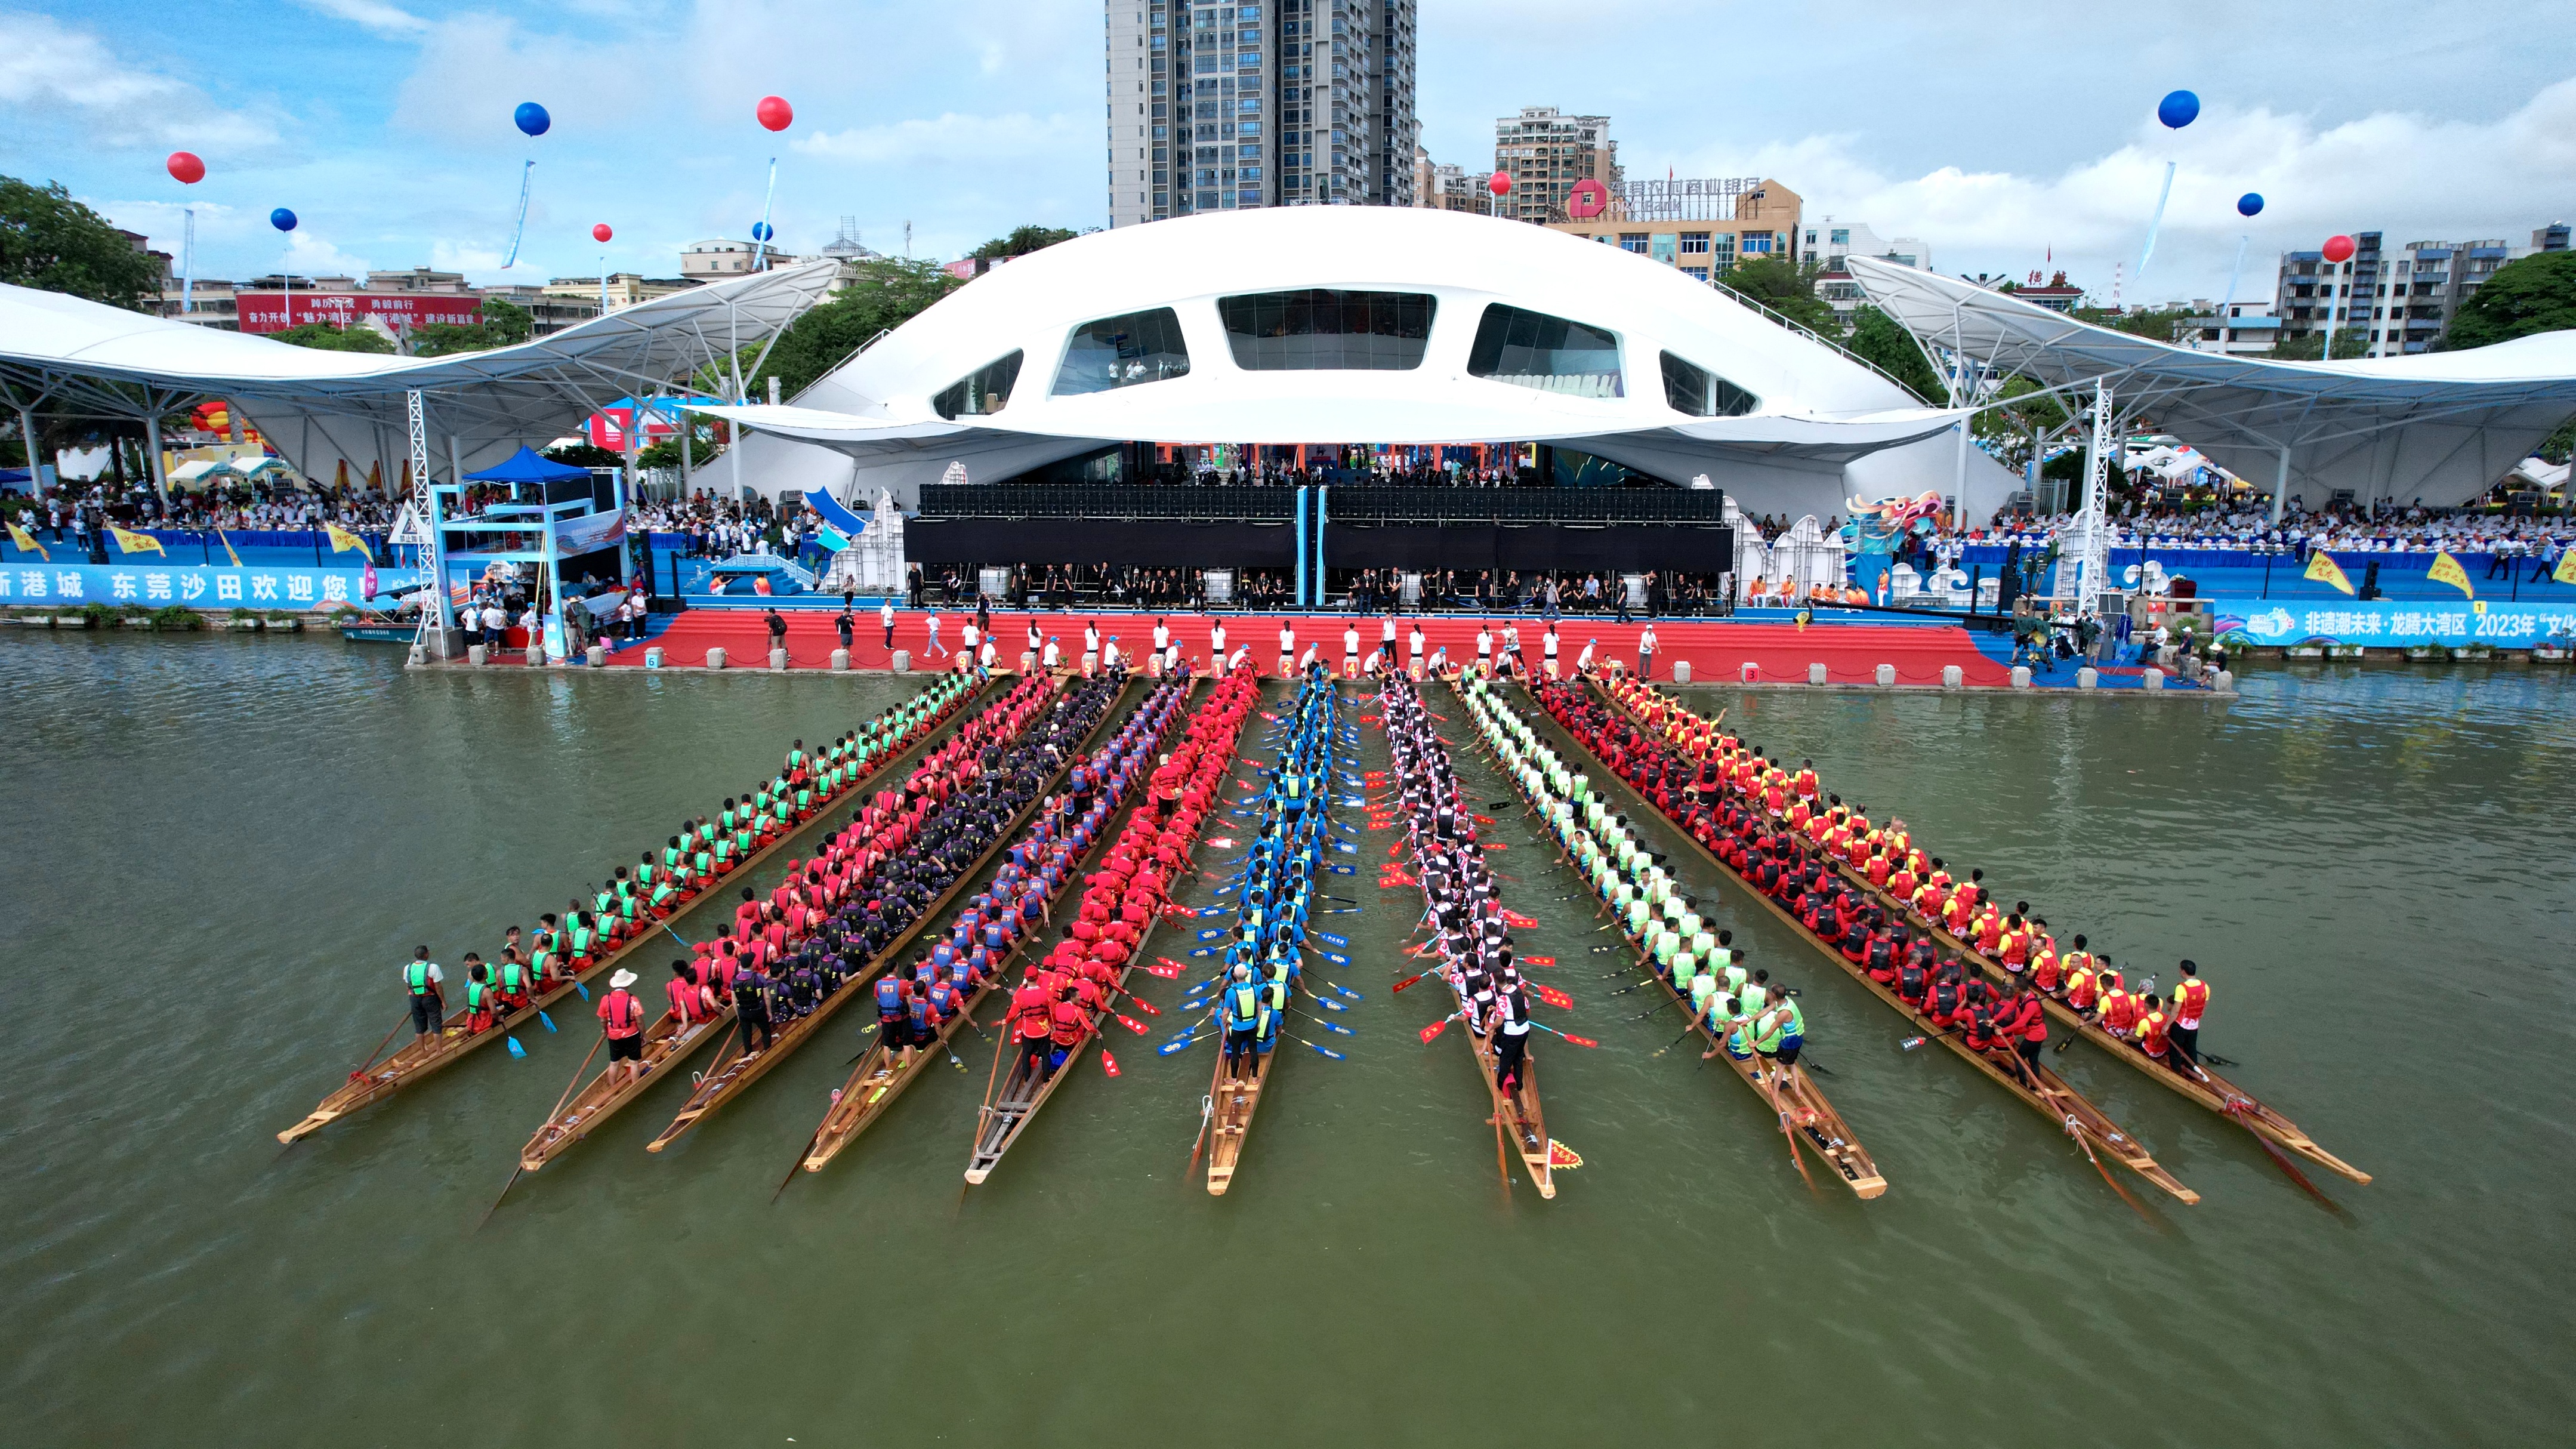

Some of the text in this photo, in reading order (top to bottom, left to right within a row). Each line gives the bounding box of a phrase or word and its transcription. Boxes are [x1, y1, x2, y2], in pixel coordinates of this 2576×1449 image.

[1611, 177, 1760, 198] 东莞农村商业银行
[1611, 199, 1682, 213] DRC Bank
[371, 299, 414, 310] 勇毅前行
[249, 312, 290, 323] 奋力开创
[425, 313, 474, 325] 建设新篇章
[2476, 603, 2482, 612] 1
[2305, 611, 2467, 636] 非遗潮未来·龙腾大湾区
[2475, 613, 2535, 637] 2023年
[959, 656, 966, 668] 9
[1022, 661, 1029, 671] 7
[1085, 662, 1092, 673] 5
[1152, 661, 1159, 672] 3
[1284, 662, 1291, 673] 2
[1215, 663, 1220, 674] 1
[1347, 664, 1356, 674] 4
[1412, 665, 1419, 677] 6
[1480, 664, 1487, 674] 8
[1548, 664, 1557, 675] 10
[1749, 670, 1755, 679] 3
